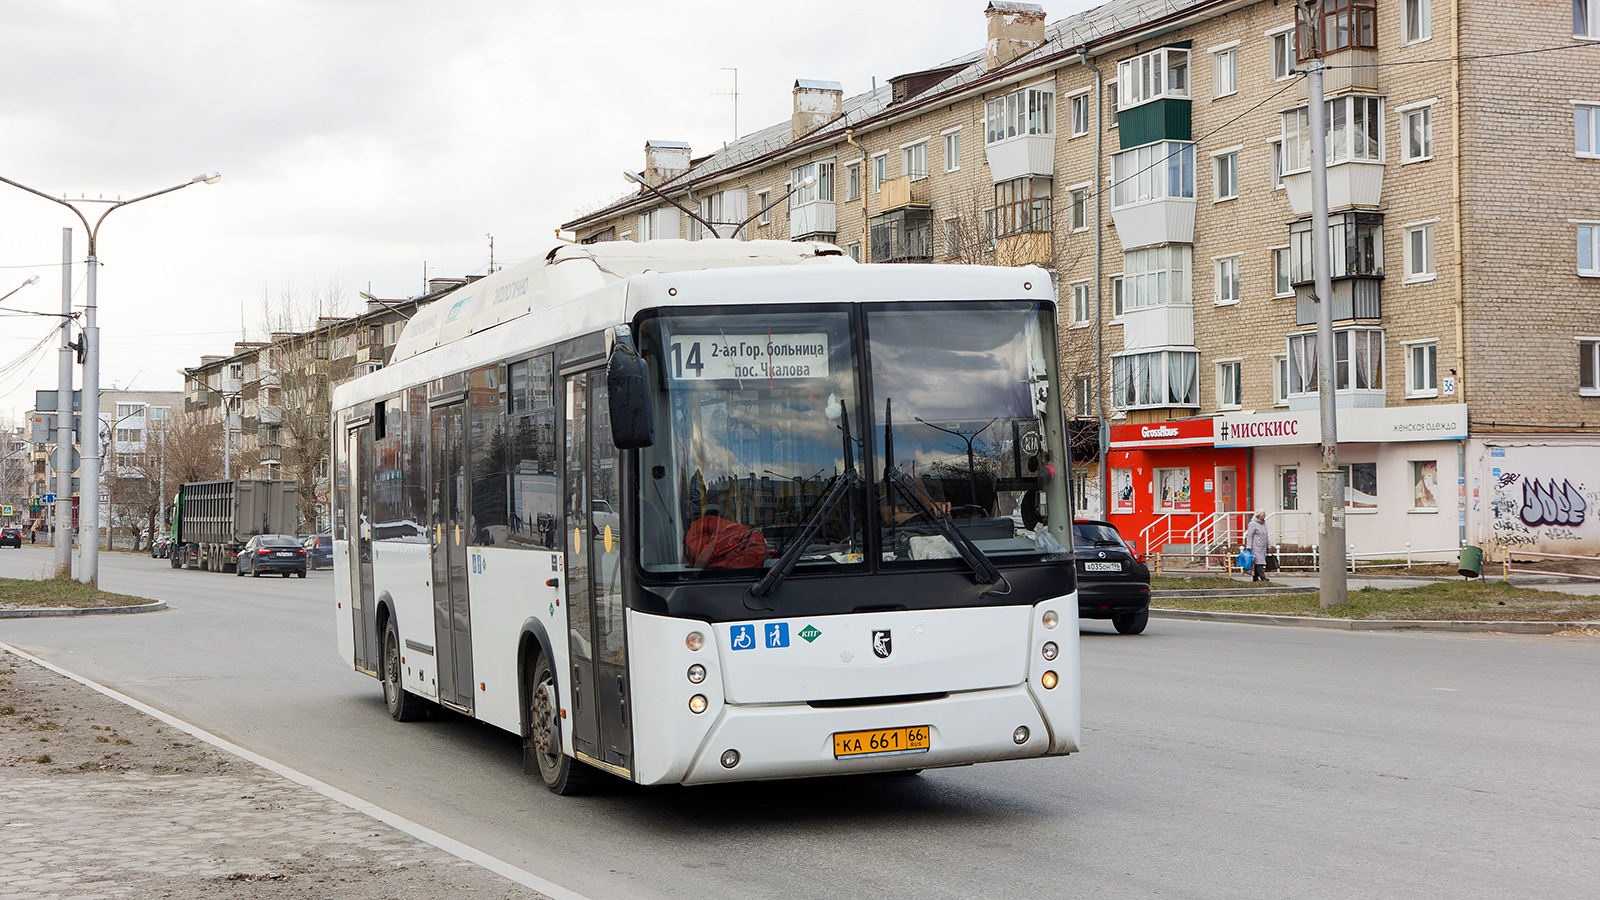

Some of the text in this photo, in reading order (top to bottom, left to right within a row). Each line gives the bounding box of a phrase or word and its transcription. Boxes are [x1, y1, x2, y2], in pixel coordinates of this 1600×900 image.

[711, 341, 824, 361] 2-ая Гор. больница
[670, 342, 704, 378] 14
[734, 362, 810, 377] пос. Чкалова
[1444, 379, 1454, 392] 36
[1141, 425, 1179, 439] GrossHaus
[1393, 421, 1456, 432] женская одежда
[870, 732, 899, 749] 661
[908, 729, 923, 742] 66
